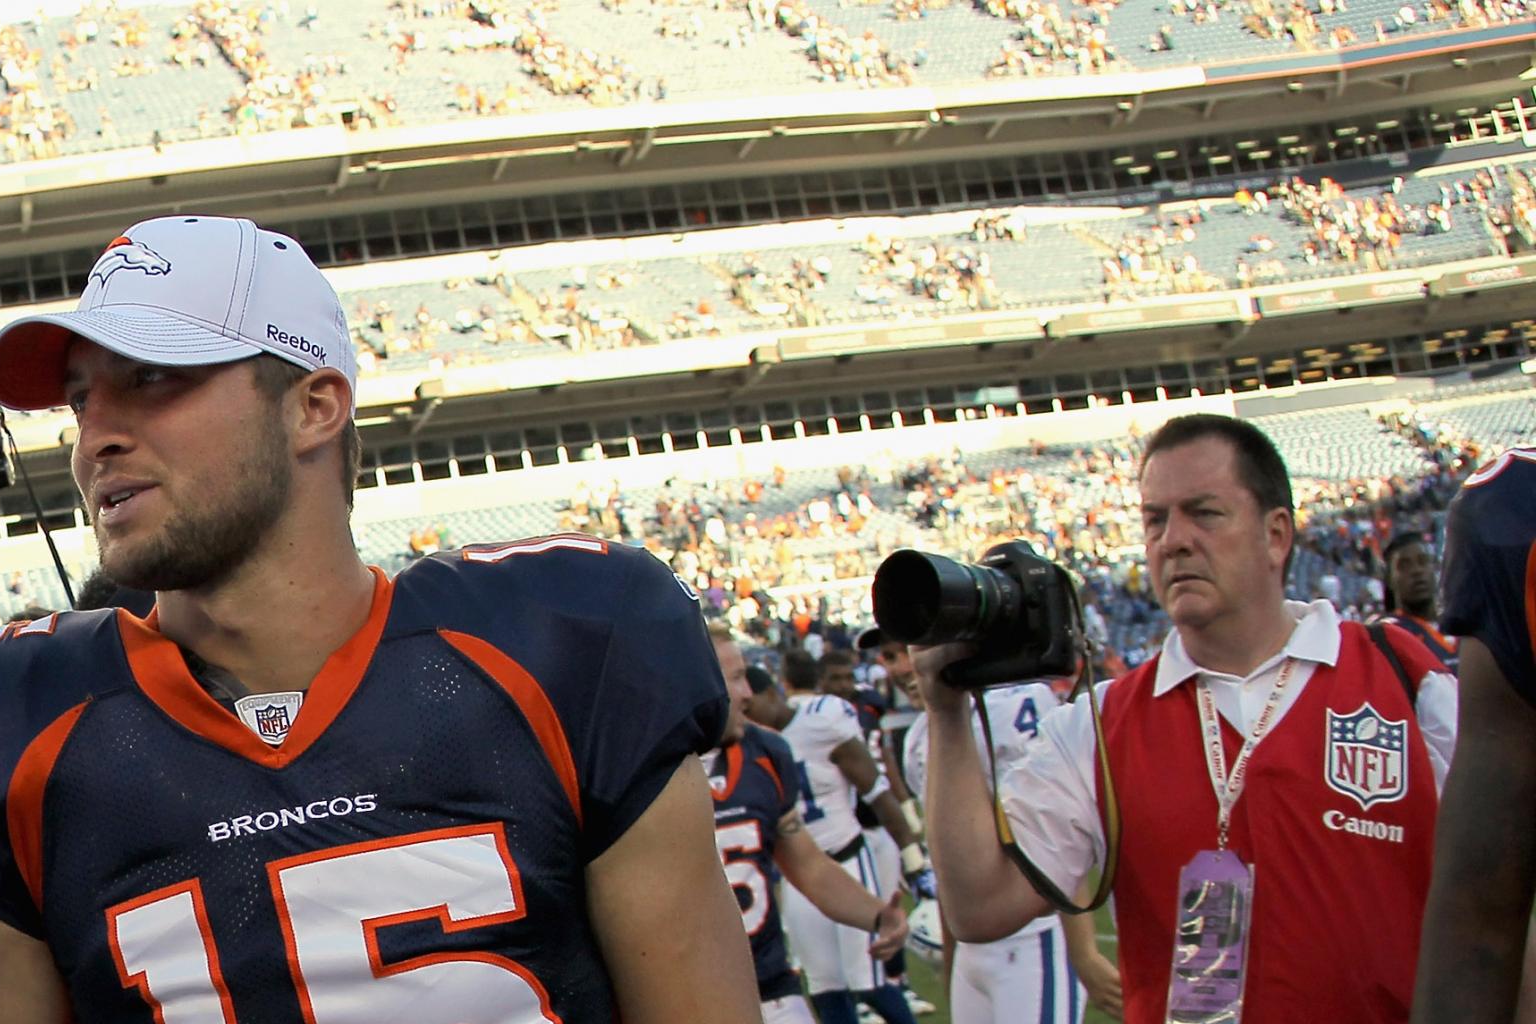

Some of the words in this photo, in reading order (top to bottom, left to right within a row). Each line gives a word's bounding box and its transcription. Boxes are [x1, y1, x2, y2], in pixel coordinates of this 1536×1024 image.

[266, 323, 327, 366] Reebok
[261, 717, 288, 734] NFL
[1335, 744, 1398, 792] NFL
[208, 794, 378, 842] BRONCOS
[1322, 809, 1405, 843] Canon
